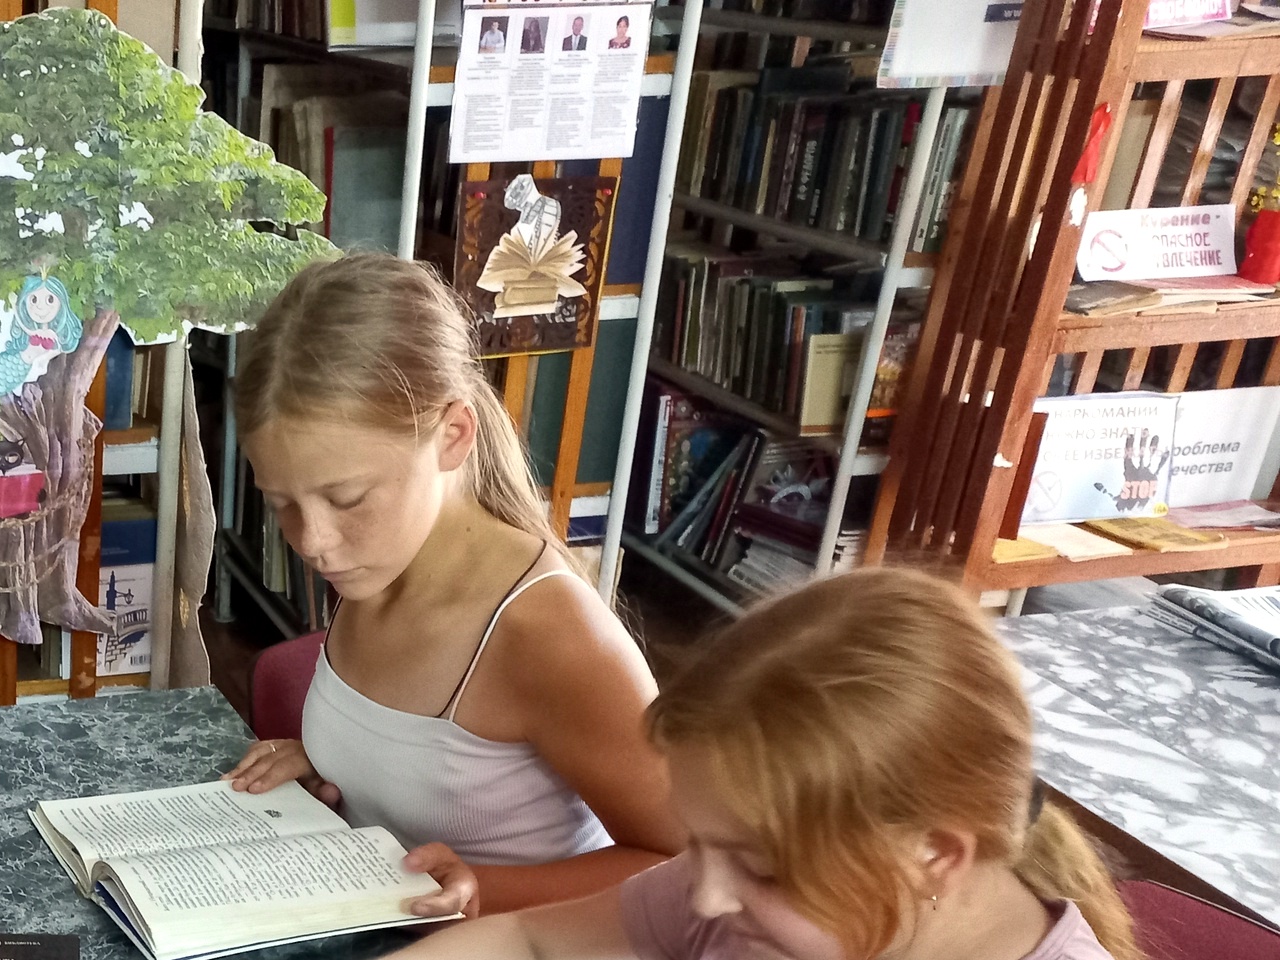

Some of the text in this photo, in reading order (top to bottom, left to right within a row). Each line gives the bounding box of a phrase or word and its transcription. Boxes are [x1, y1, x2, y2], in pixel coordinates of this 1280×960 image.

[1140, 213, 1211, 229] Курение
[1154, 249, 1223, 269] ВЛЕЧЕНИЕ
[1170, 441, 1241, 458] роблема
[1170, 461, 1233, 476] ечества
[1120, 480, 1157, 500] STOP
